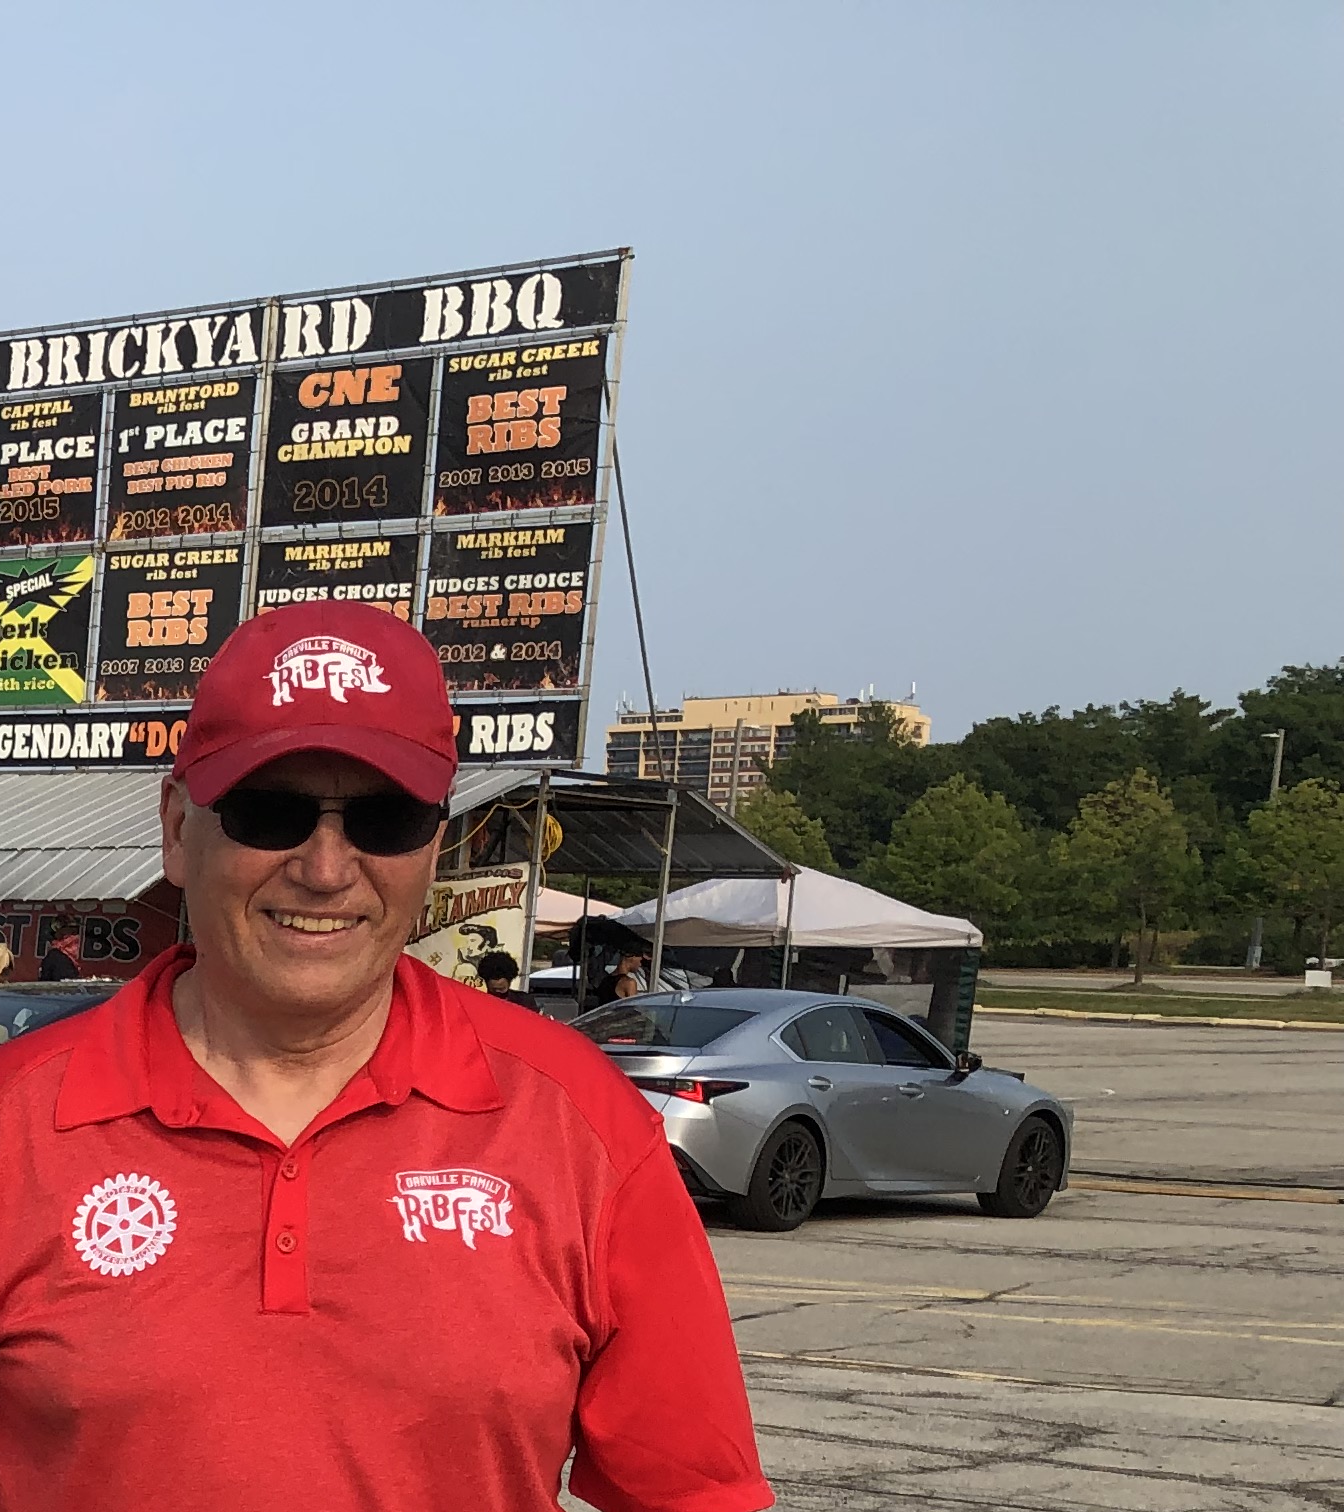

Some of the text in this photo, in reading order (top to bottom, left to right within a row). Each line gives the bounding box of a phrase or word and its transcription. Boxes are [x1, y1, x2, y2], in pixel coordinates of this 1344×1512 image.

[419, 273, 564, 343] BBQ
[448, 340, 600, 373] SUGAR CREEK
[488, 364, 549, 382] rib fest
[129, 382, 240, 407] BRANTFORD
[298, 364, 402, 409] CNE
[1, 400, 73, 420] CAPITAL
[157, 399, 206, 415] rib fest
[467, 385, 567, 424] BEST
[10, 416, 57, 431] rib fest
[118, 417, 247, 453] 1st PLACE
[291, 416, 400, 444] GRAND
[466, 417, 562, 455] RIBS
[0, 435, 95, 465] PLACE
[277, 434, 413, 462] CHAMPION
[8, 465, 51, 482] BEST
[123, 453, 234, 477] BEST CHICKEN
[439, 458, 591, 488] 2007 2013 2015
[38, 477, 92, 498] PORK
[127, 472, 227, 495] BEST PIG RIG
[293, 475, 388, 513] 2014
[122, 502, 231, 532] 2012 2014
[285, 541, 391, 562] MARKHAM
[457, 529, 565, 550] MARKHAM
[110, 548, 239, 570] SUGAR CREEK
[308, 556, 363, 571] rib fest
[481, 545, 537, 560] rib fest
[5, 572, 54, 600] SPECIAL
[146, 568, 198, 581] rib fest
[428, 571, 584, 598] JUDGES CHOICE
[126, 589, 213, 619] BEST
[258, 582, 412, 608] JUDGES CHOICE
[426, 594, 503, 621] BEST
[508, 591, 584, 615] RIBS
[125, 617, 208, 648] RIBS
[462, 616, 541, 629] runner up
[282, 640, 370, 663] OAKVILLE FAMILY
[438, 641, 562, 662] 2012 & 2014
[101, 660, 140, 675] 2007
[144, 659, 184, 674] 2013
[22, 678, 55, 691] rice
[469, 712, 555, 754] RIBS
[432, 881, 528, 931] FAMILY
[405, 1174, 502, 1195] OAKVILLE FAMILY
